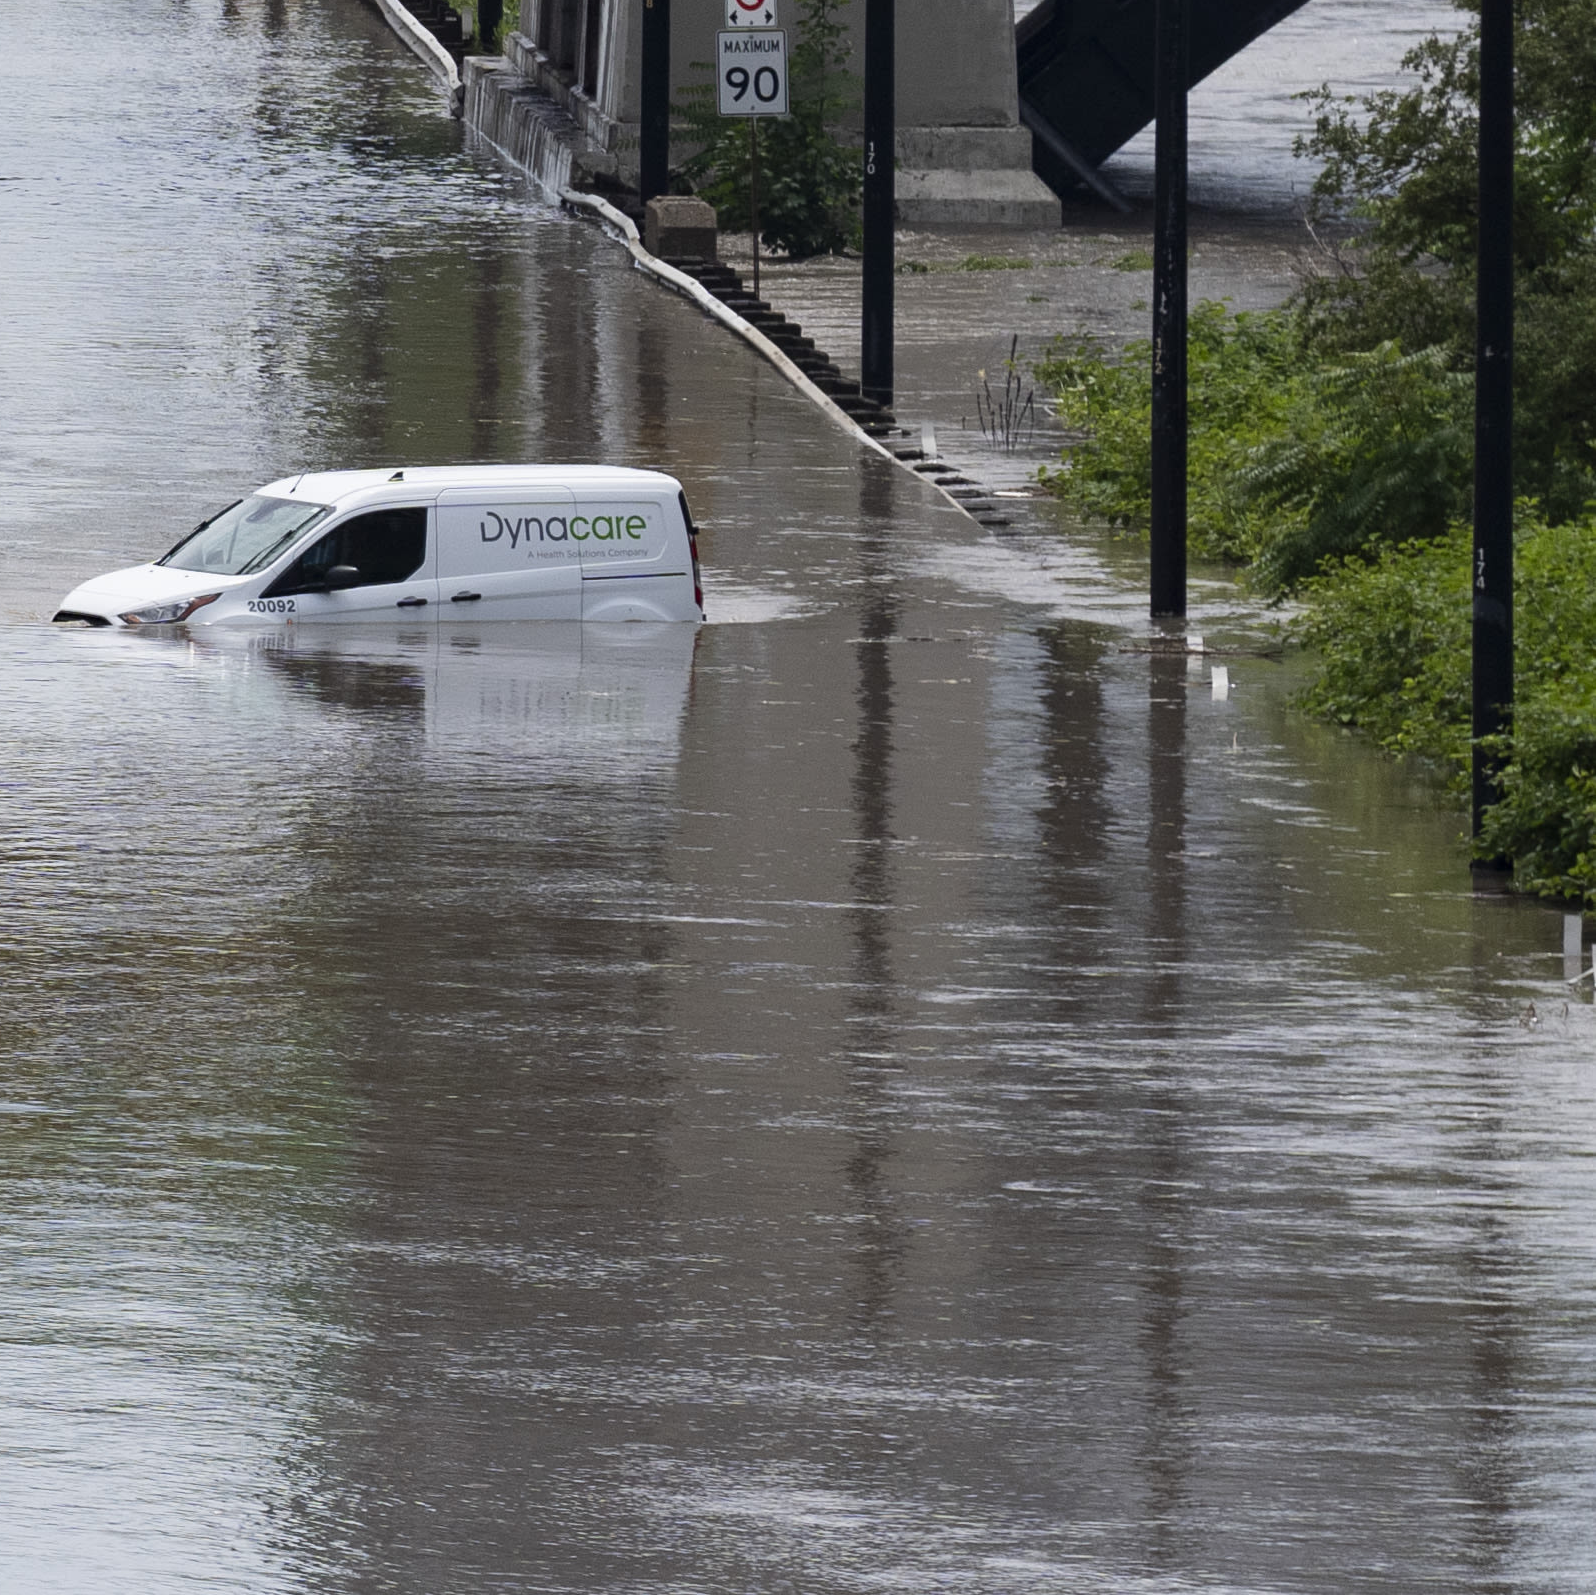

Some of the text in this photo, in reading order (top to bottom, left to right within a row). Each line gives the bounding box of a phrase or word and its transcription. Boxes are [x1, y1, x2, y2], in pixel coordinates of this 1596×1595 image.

[724, 39, 780, 54] MAXIMUM
[725, 65, 780, 103] 90
[866, 141, 876, 175] 170
[480, 511, 647, 549] Dynacare
[527, 548, 648, 561] A Health Solutions Company
[1476, 547, 1486, 590] 174
[247, 599, 297, 613] 20092
